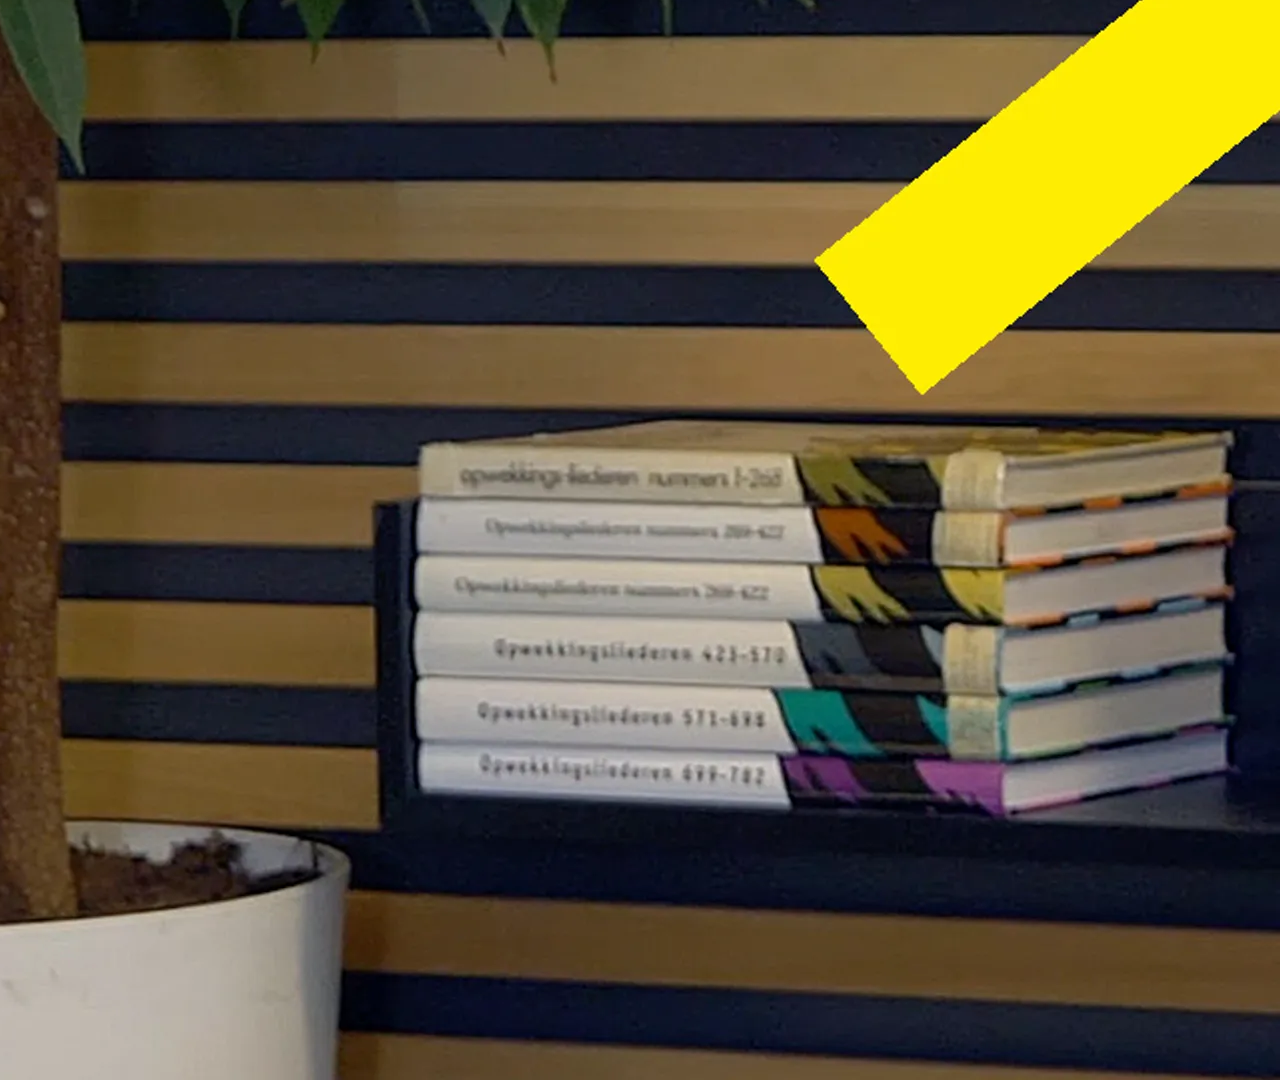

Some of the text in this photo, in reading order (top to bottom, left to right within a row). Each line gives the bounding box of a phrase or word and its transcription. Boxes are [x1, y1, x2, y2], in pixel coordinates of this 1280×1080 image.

[648, 471, 730, 489] nummers
[646, 524, 719, 539] nummers
[624, 584, 701, 599] nummers
[493, 637, 786, 665] Opwekkingsliederen 423-570
[477, 701, 766, 729] Opwekkingsliederen 571-698
[478, 752, 766, 786] Opwekkingsliederen 699-782
